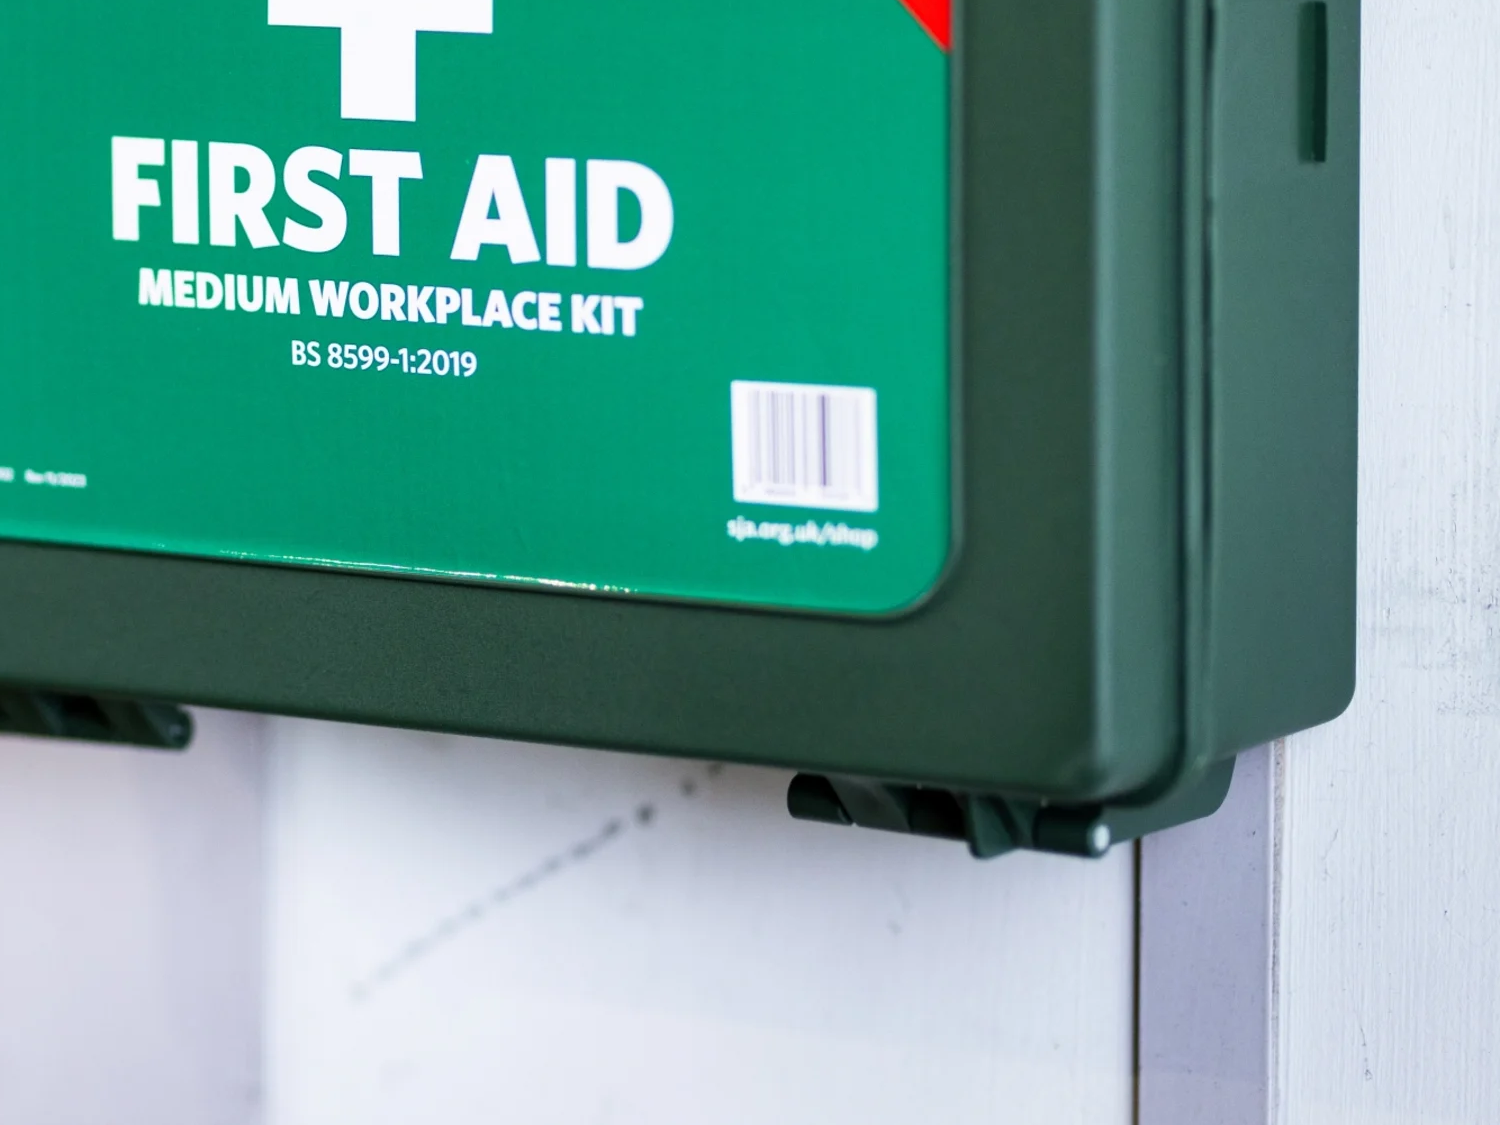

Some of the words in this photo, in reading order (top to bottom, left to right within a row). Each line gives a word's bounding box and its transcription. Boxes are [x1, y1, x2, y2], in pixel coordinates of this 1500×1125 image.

[111, 135, 424, 257] FIRST
[450, 154, 674, 270] AID
[138, 267, 301, 315] MEDIUM
[308, 279, 563, 332] WORKPLACE
[570, 293, 644, 337] KIT
[291, 340, 321, 367] BS
[327, 342, 477, 377] 8599-1:2019
